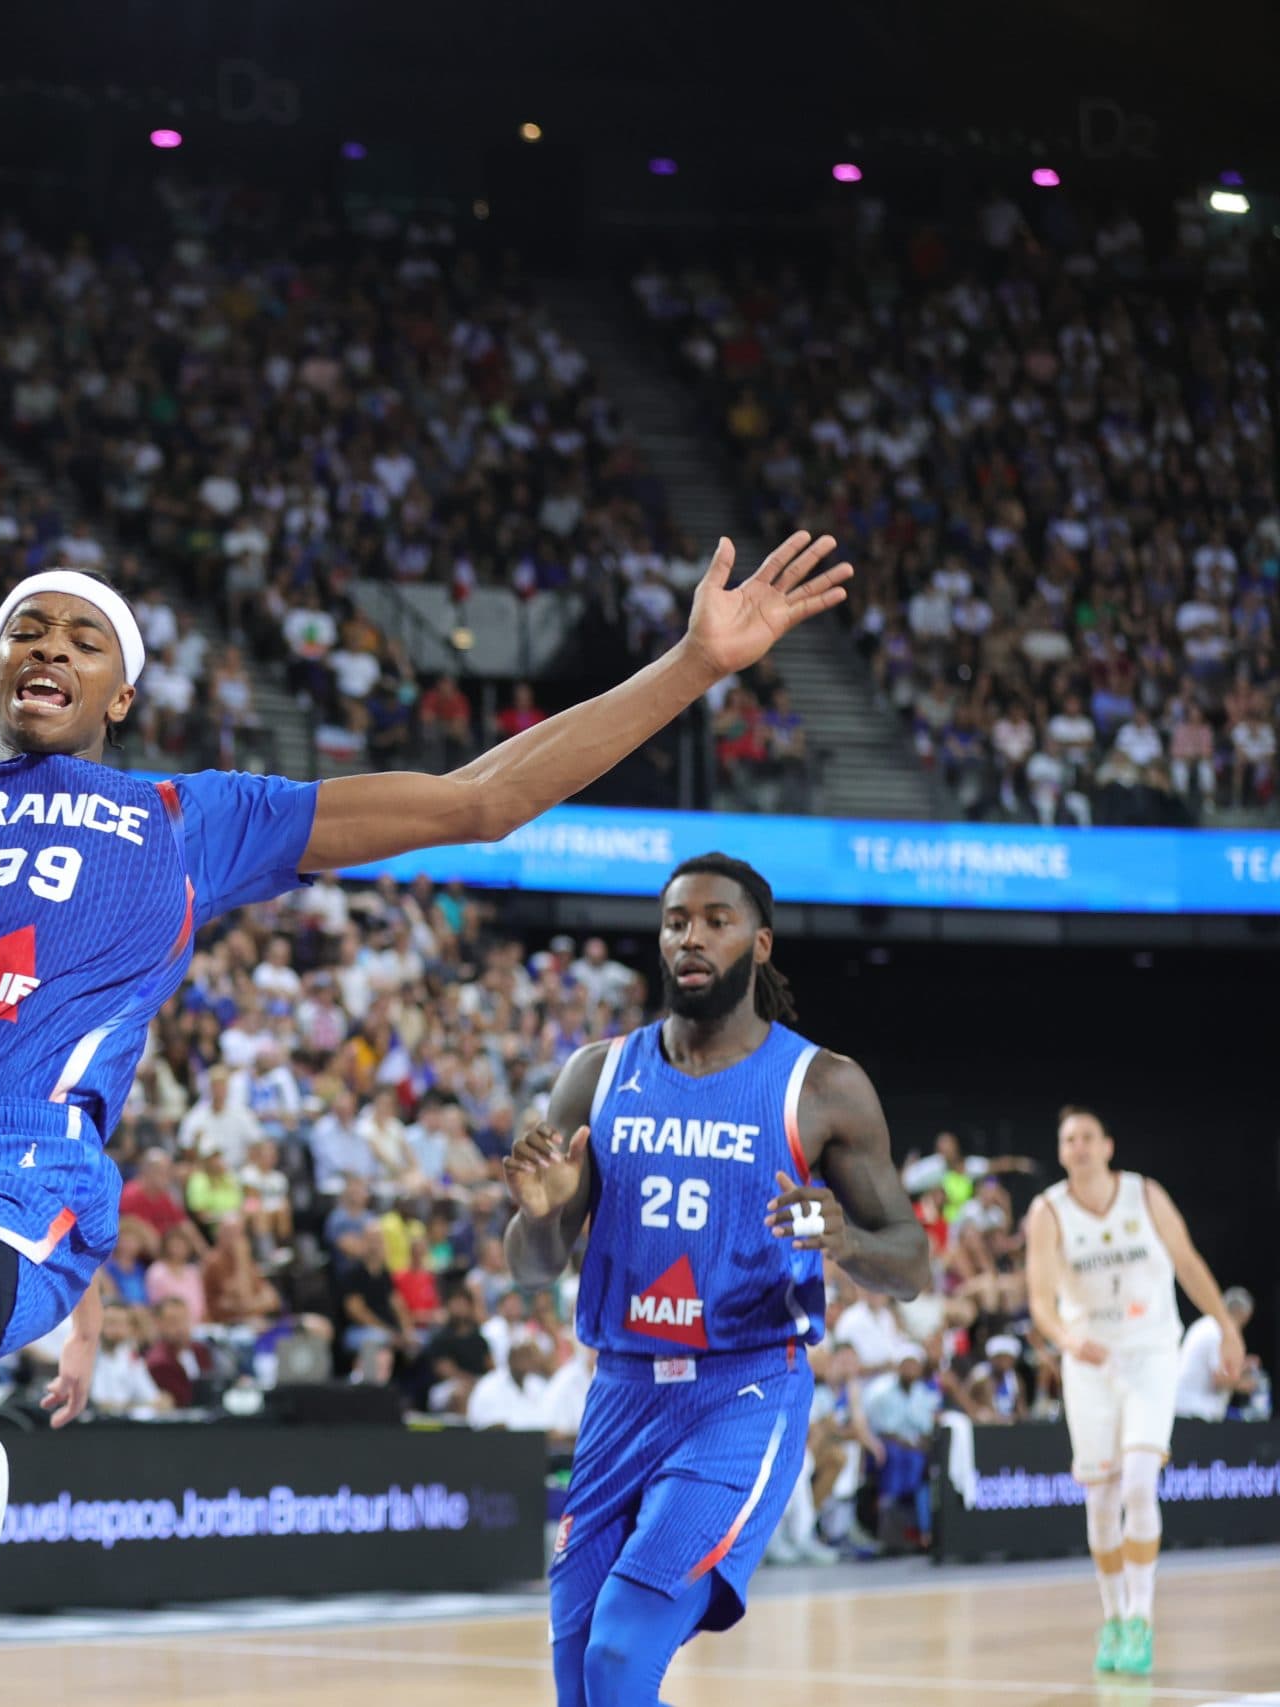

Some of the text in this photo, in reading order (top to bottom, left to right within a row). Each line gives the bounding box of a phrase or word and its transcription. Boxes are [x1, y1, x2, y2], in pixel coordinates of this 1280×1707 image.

[611, 1117, 760, 1163] FRANCE
[641, 1175, 710, 1231] 26
[631, 1295, 704, 1327] MAIF
